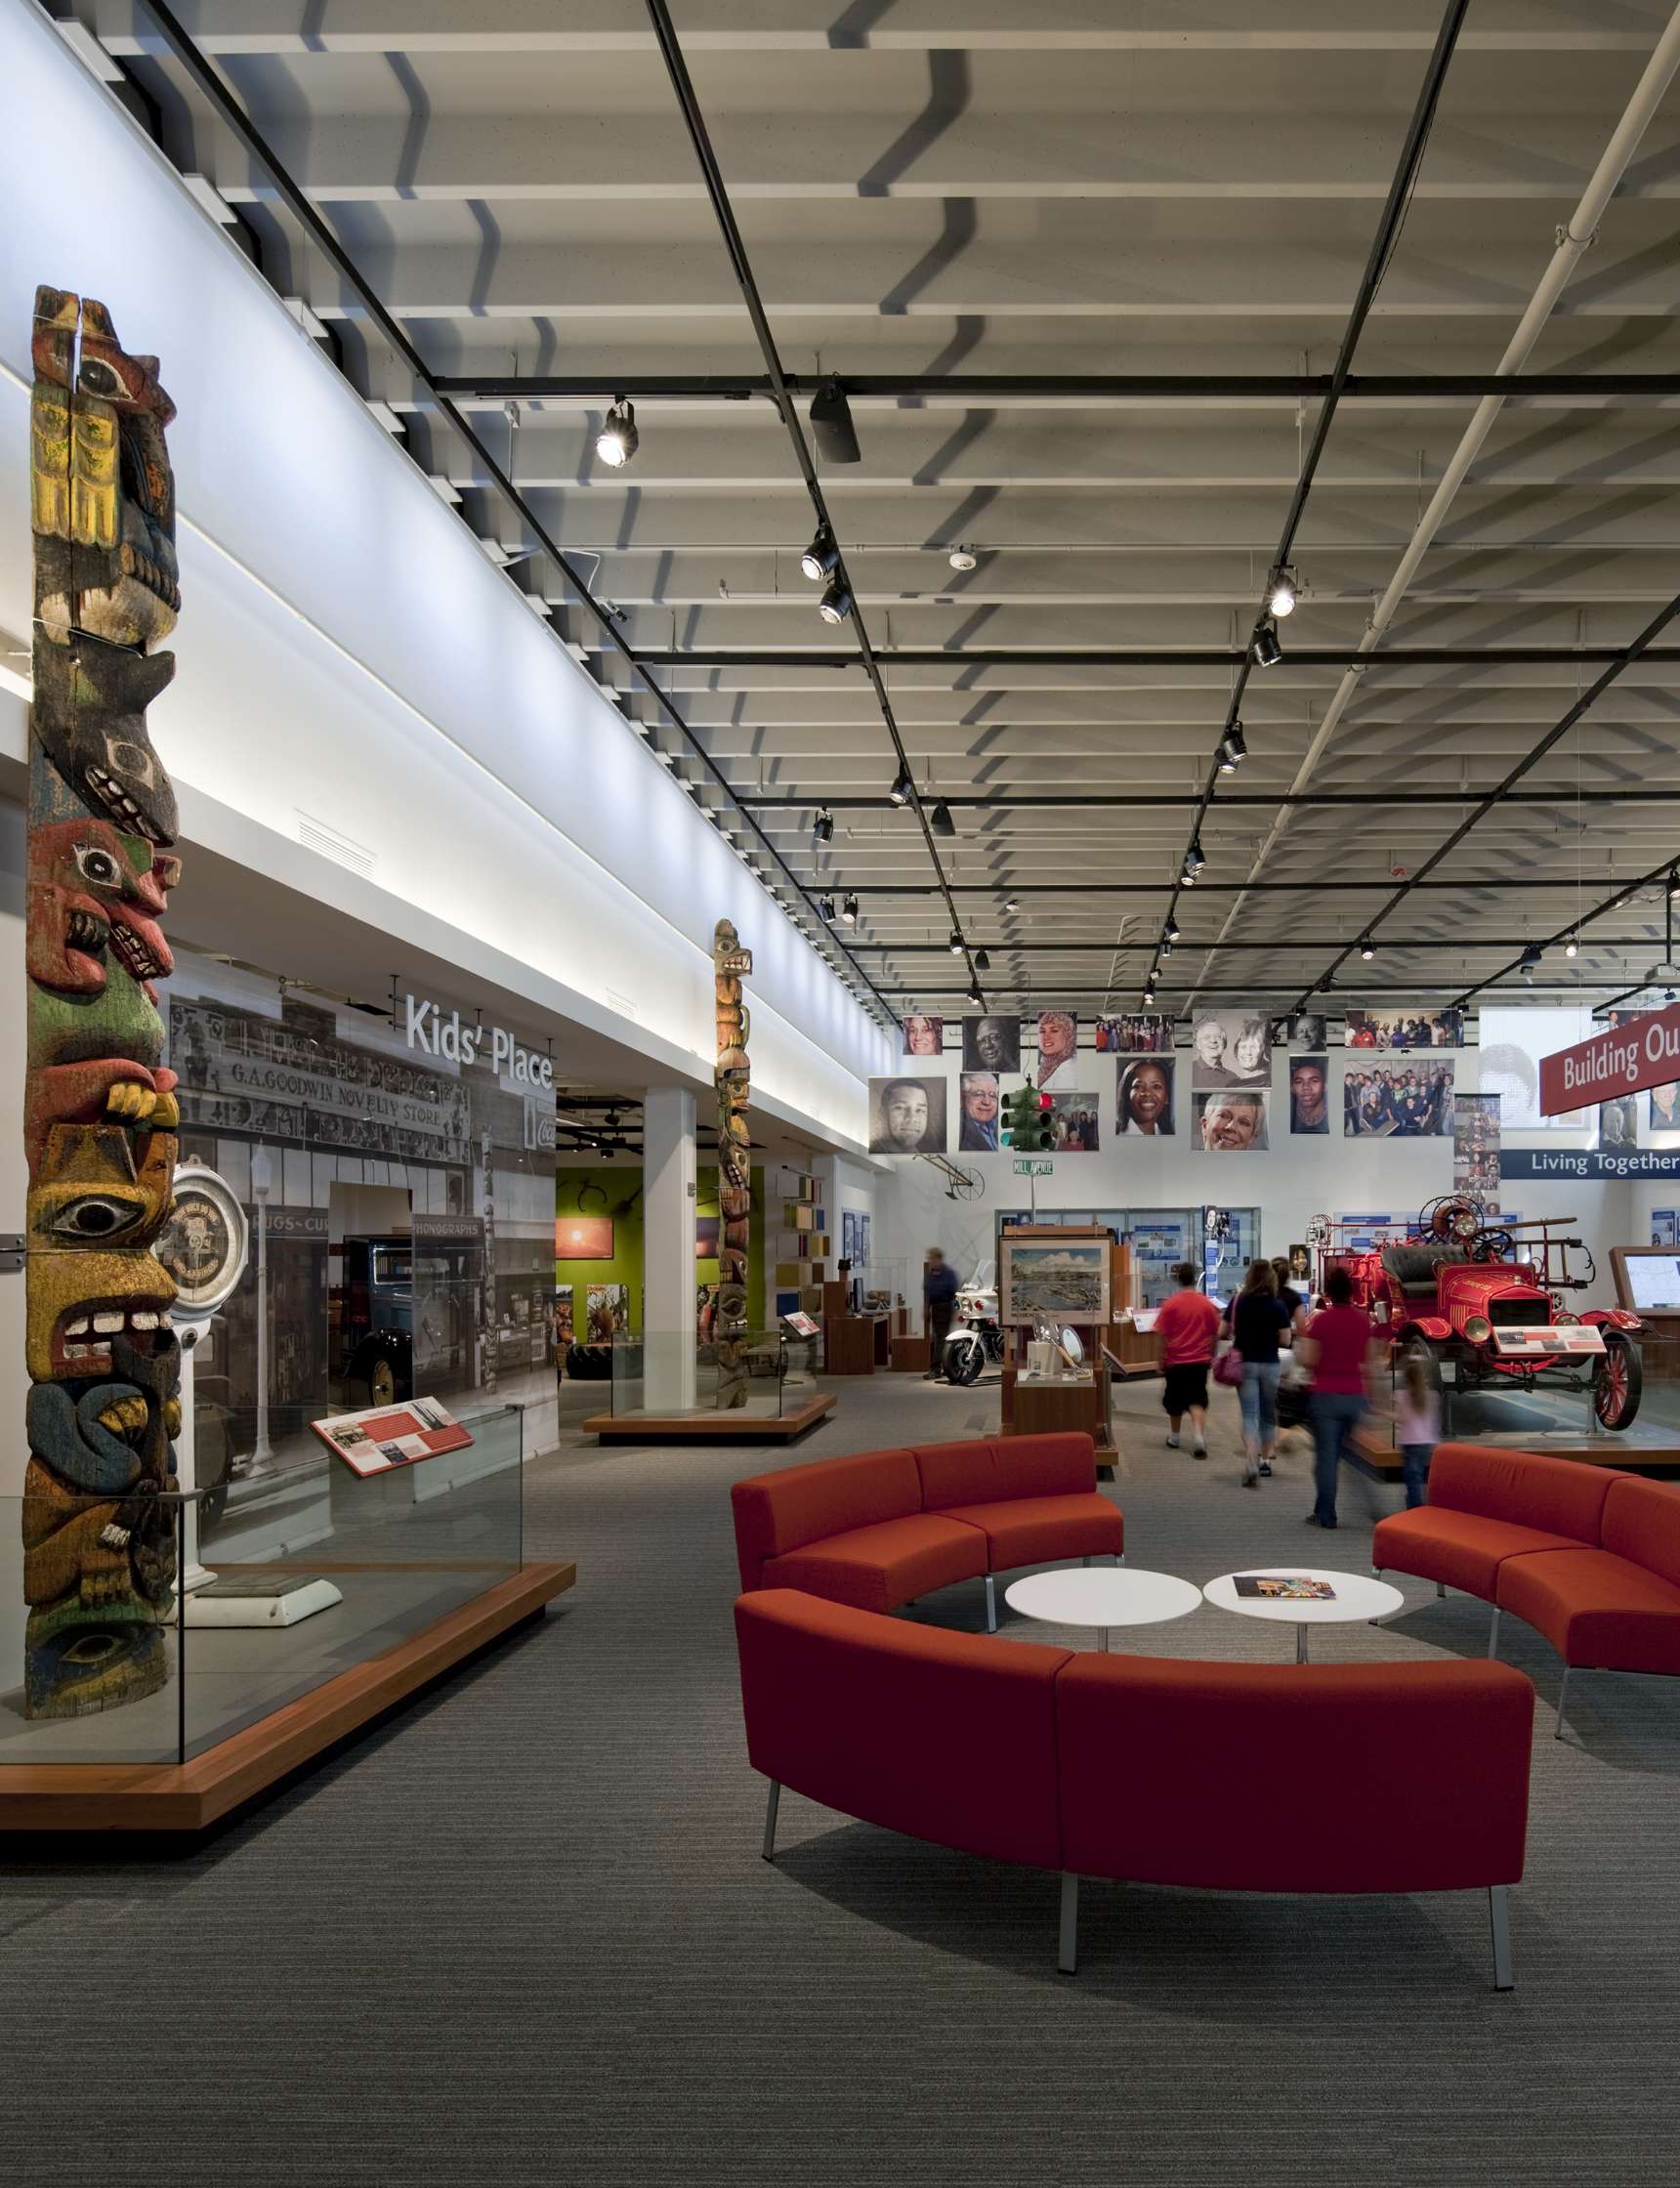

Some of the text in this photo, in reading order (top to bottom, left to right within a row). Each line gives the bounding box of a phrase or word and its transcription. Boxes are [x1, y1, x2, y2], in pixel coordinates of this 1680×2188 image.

[405, 993, 553, 1090] Kids' Place
[1564, 1041, 1639, 1082] Building
[339, 1086, 399, 1115] NOVELTY
[1014, 1160, 1053, 1174] MILL AVENUE
[1532, 1153, 1680, 1175] Living Together
